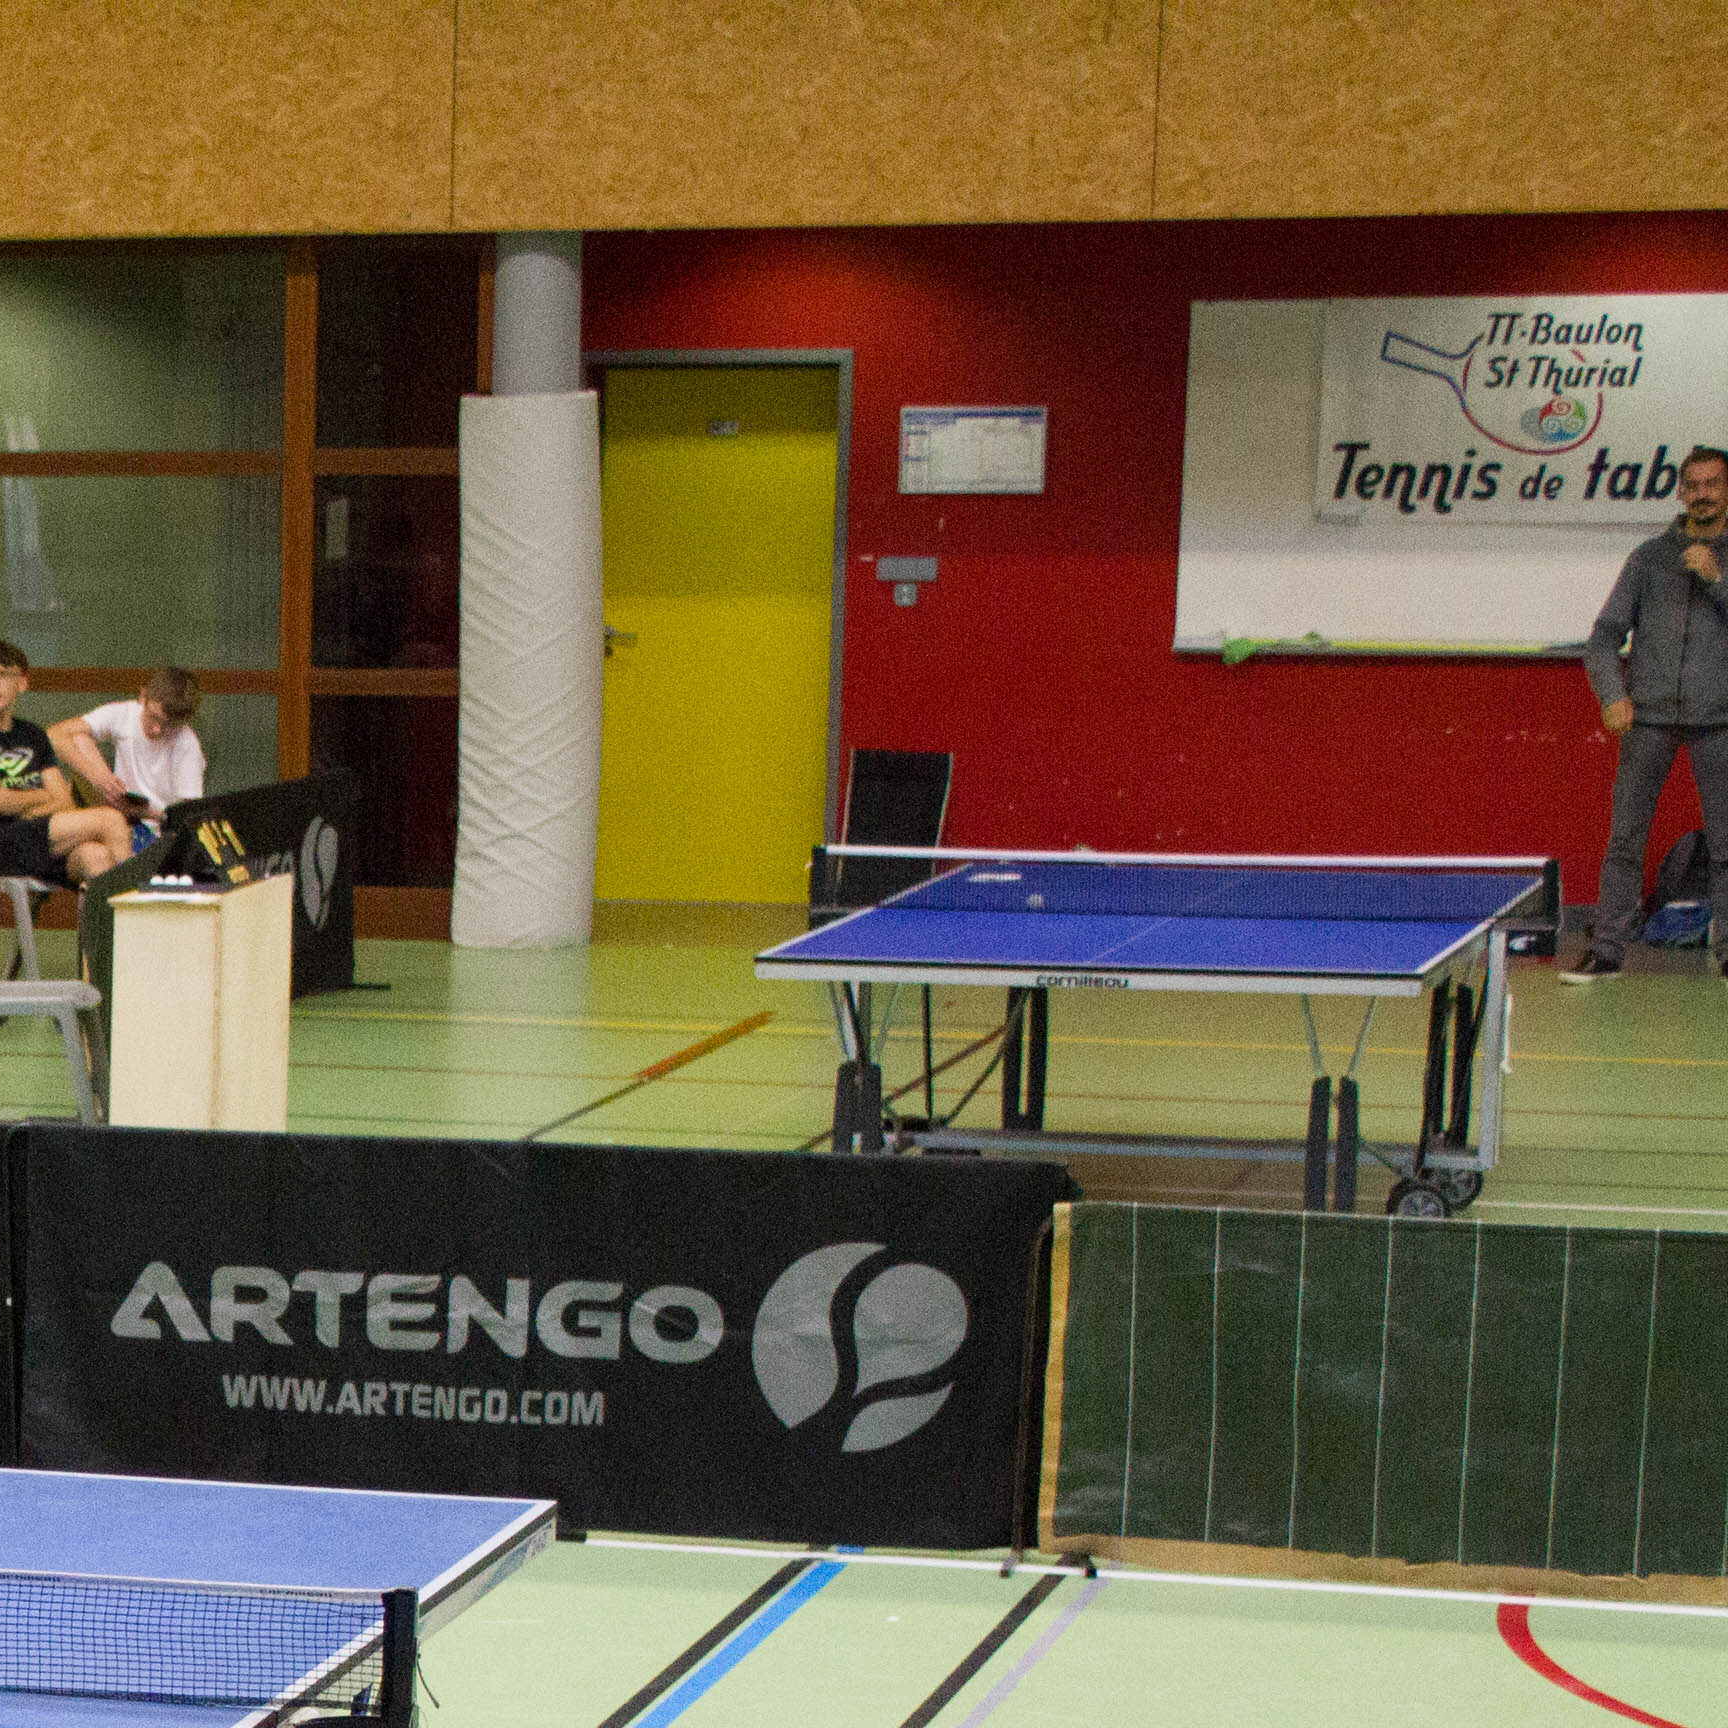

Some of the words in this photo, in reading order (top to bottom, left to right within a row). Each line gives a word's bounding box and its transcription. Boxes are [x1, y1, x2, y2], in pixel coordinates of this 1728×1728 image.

[1483, 356, 1521, 389] St
[1528, 355, 1643, 396] Thurial
[1332, 441, 1504, 515] Tennis
[1518, 463, 1564, 500] de
[1584, 443, 1706, 501] tab
[110, 1260, 725, 1364] ARTENGO
[222, 1373, 606, 1426] WWW.ARTENGO.COM
